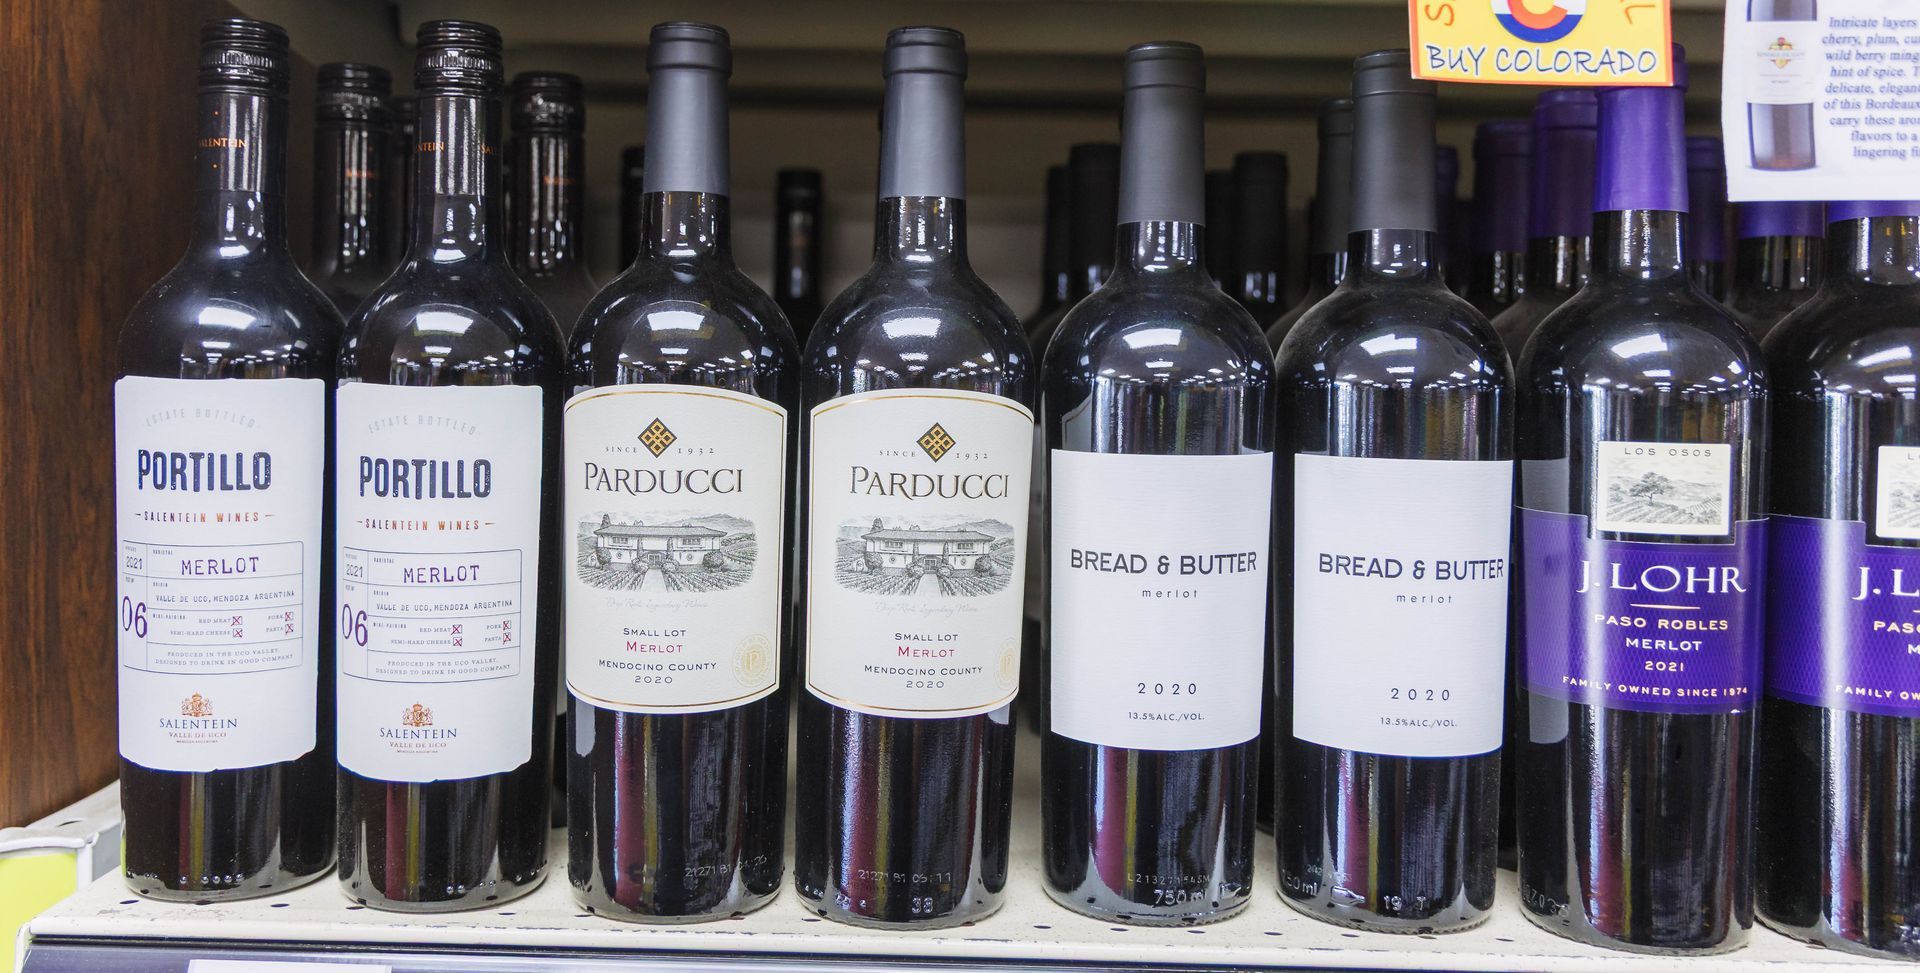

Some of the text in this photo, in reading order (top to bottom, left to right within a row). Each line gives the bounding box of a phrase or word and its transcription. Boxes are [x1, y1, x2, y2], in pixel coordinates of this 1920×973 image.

[1829, 16, 1918, 30] Intricate layers
[1822, 33, 1861, 46] cherry,
[1866, 33, 1899, 47] plum,
[1426, 45, 1657, 76] BUY COLORADO
[1825, 49, 1851, 60] wild
[1856, 49, 1886, 63] berry
[1830, 66, 1853, 77] hint
[1857, 65, 1872, 77] of
[1825, 81, 1874, 94] delicate,
[1823, 98, 1838, 110] of
[1840, 98, 1861, 110] this
[1829, 117, 1859, 128] carry
[1864, 114, 1895, 125] these
[1851, 130, 1918, 141] flavors to a
[199, 137, 247, 148] ALENTEIN
[1853, 145, 1907, 160] lingering
[146, 407, 257, 429] ESTATE BOTTLED
[368, 414, 476, 436] ESTATE BOTTLED
[605, 446, 715, 456] SINCE 1932
[879, 449, 988, 461] SINCE 1932
[1624, 447, 1712, 458] LOS OSOS
[137, 449, 272, 493] PORTILLO
[359, 455, 492, 500] PORTILLO
[584, 462, 744, 497] PARDUCCI
[850, 466, 1009, 501] PARDUCCI
[144, 511, 260, 523] SALENTEIN WINES
[365, 518, 480, 531] SALENTEIN WINES
[126, 555, 143, 570] 2021
[181, 556, 260, 576] MERLOT
[1071, 548, 1257, 576] BREAD & BUTTER
[1319, 552, 1504, 581] BREAD & BUTTER
[346, 563, 364, 579] 2021
[402, 564, 480, 584] MERLOT
[1610, 562, 1747, 594] LOHR
[156, 595, 176, 603] VALLE
[179, 595, 189, 603] DE
[254, 590, 295, 601] ARGENTINA
[1141, 588, 1198, 599] merlot
[1396, 594, 1452, 604] merlot
[376, 603, 397, 611] VALLE
[401, 604, 410, 612] DE
[473, 599, 513, 610] ARGENTINA
[122, 595, 148, 639] 06
[1594, 614, 1729, 631] PASO ROBLES
[341, 603, 368, 647] 06
[623, 627, 687, 637] SMALL LOT
[894, 632, 959, 642] SMALL LOT
[626, 640, 684, 653] MERLOT
[1625, 637, 1703, 652] MERLOT
[216, 650, 232, 658] THE
[234, 649, 251, 657] UCO
[898, 646, 955, 658] MERLOT
[155, 658, 187, 666] DESIGNED
[189, 659, 199, 667] TO
[227, 658, 237, 666] IN
[239, 657, 260, 665] GOOD
[387, 660, 423, 668] PRODUCED
[426, 660, 435, 668] IN
[437, 659, 452, 667] THE
[598, 659, 717, 672] MENDOCINO COUNTY
[1644, 660, 1685, 673] 2021
[375, 663, 511, 676] DESIGNED TO DRINK IN GOOD COMPANY
[864, 664, 984, 676] MENDOCINO COUNTY
[634, 675, 673, 684] 2020
[905, 680, 945, 689] 2020
[1137, 682, 1198, 695] 2020
[1562, 676, 1748, 698] FAMILY OWNED SINCE 1974
[1836, 683, 1893, 699] FAMILY
[1390, 687, 1451, 701] 2020
[159, 718, 238, 730] SALENTEIN
[379, 727, 457, 740] SALENTEIN
[428, 741, 447, 749] UCO
[1153, 888, 1187, 905] 750
